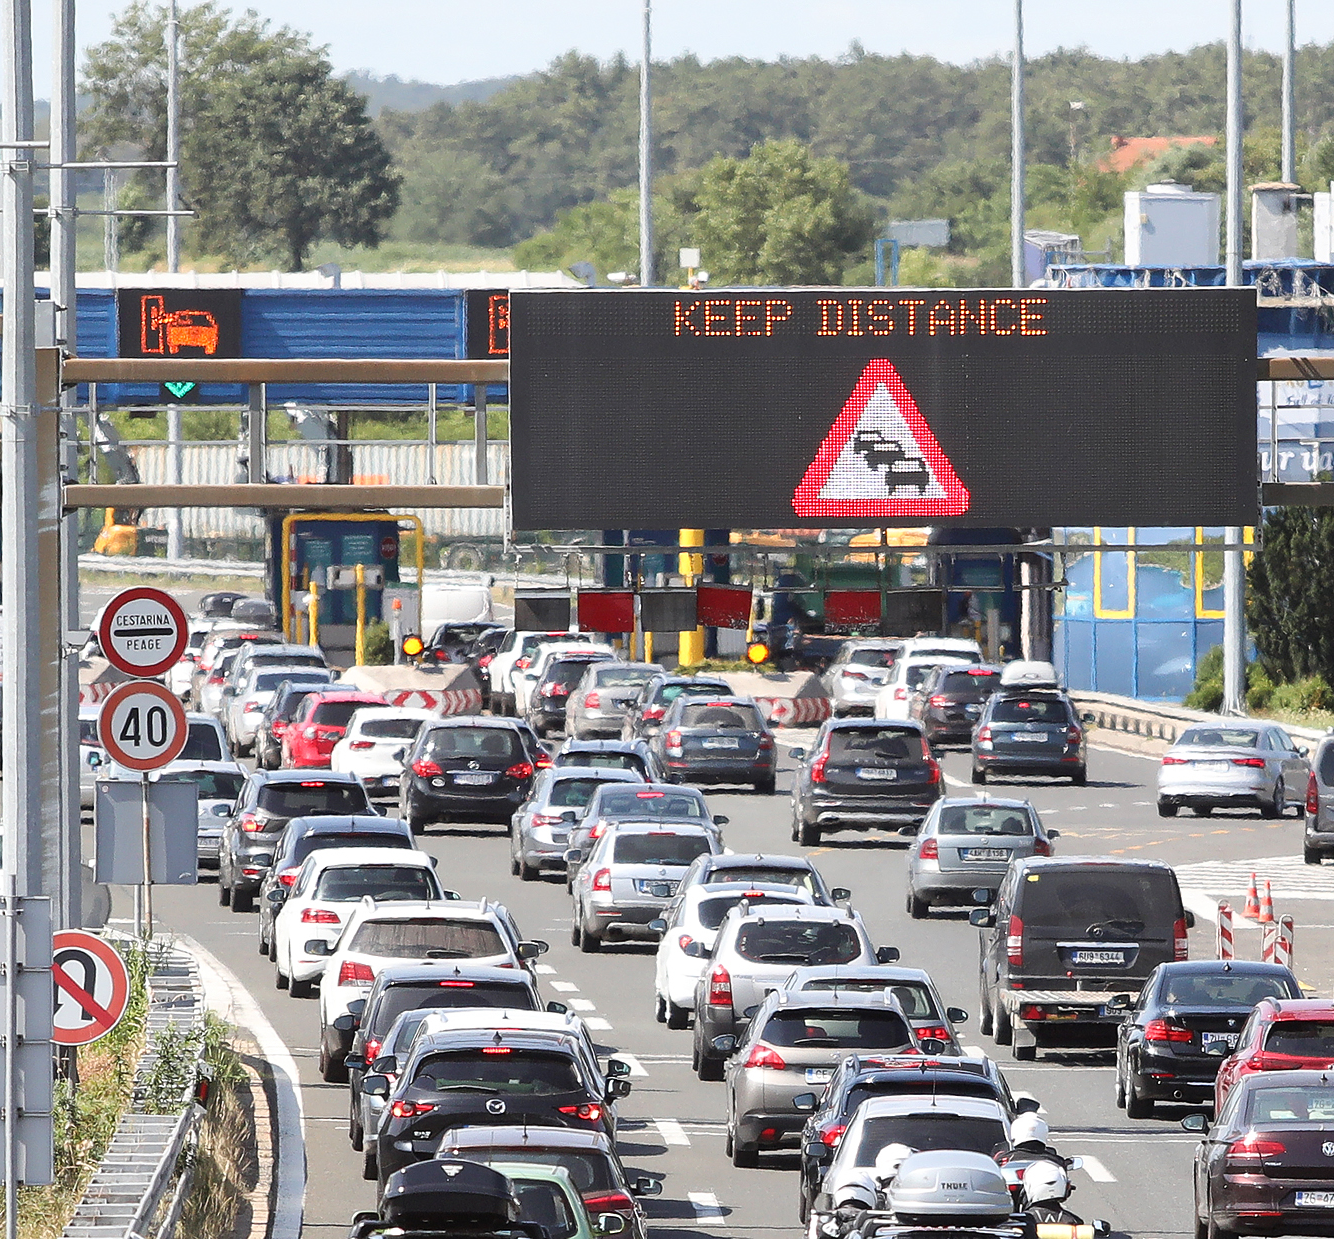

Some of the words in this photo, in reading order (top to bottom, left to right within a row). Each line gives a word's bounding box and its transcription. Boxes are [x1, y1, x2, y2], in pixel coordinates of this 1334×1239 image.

[674, 299, 793, 336] KEEP
[816, 298, 1048, 336] DISTANCE
[116, 614, 170, 627] CESTARINA
[126, 638, 162, 651] PEAGE
[119, 705, 168, 747] 40
[941, 1182, 968, 1190] THULE
